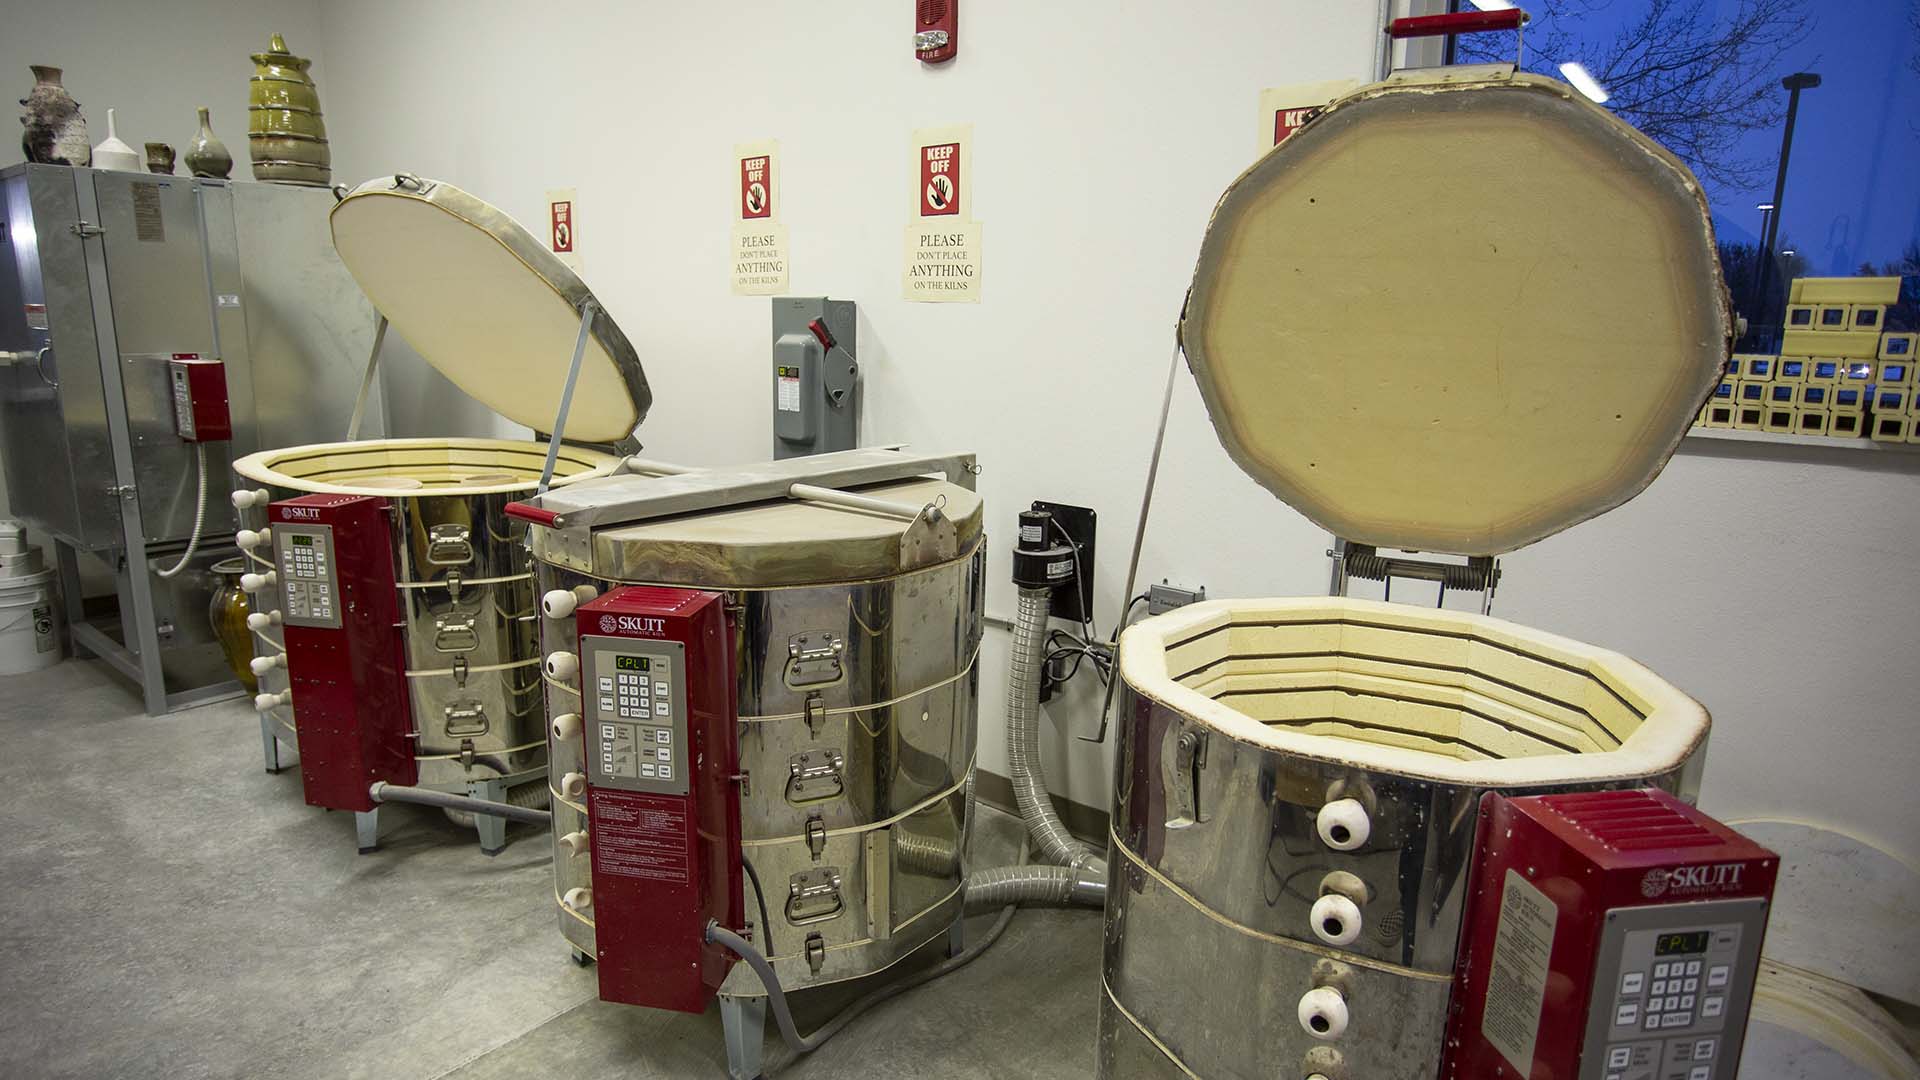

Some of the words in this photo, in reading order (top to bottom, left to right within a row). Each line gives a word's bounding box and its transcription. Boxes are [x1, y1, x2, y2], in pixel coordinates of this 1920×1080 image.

[922, 50, 940, 59] FIRE
[926, 146, 954, 161] KEEP
[745, 158, 765, 171] KEEP
[930, 160, 950, 174] OFF
[748, 170, 763, 182] OFF
[742, 235, 775, 248] PLEASE
[920, 234, 964, 247] PLEASE
[759, 250, 778, 258] PLACE
[916, 251, 941, 260] DON'T
[942, 251, 968, 260] PLACE
[736, 261, 782, 274] ANYTHING
[909, 264, 973, 277] ANYTHING
[761, 276, 779, 284] KILNS
[914, 281, 926, 289] ON
[927, 281, 942, 289] THE
[944, 281, 968, 290] KILNS
[292, 507, 320, 518] SKUTT
[618, 616, 665, 632] SKUTT
[618, 657, 647, 669] CPLT
[1670, 864, 1745, 888] SKUTT
[1657, 935, 1704, 952] CPLT
